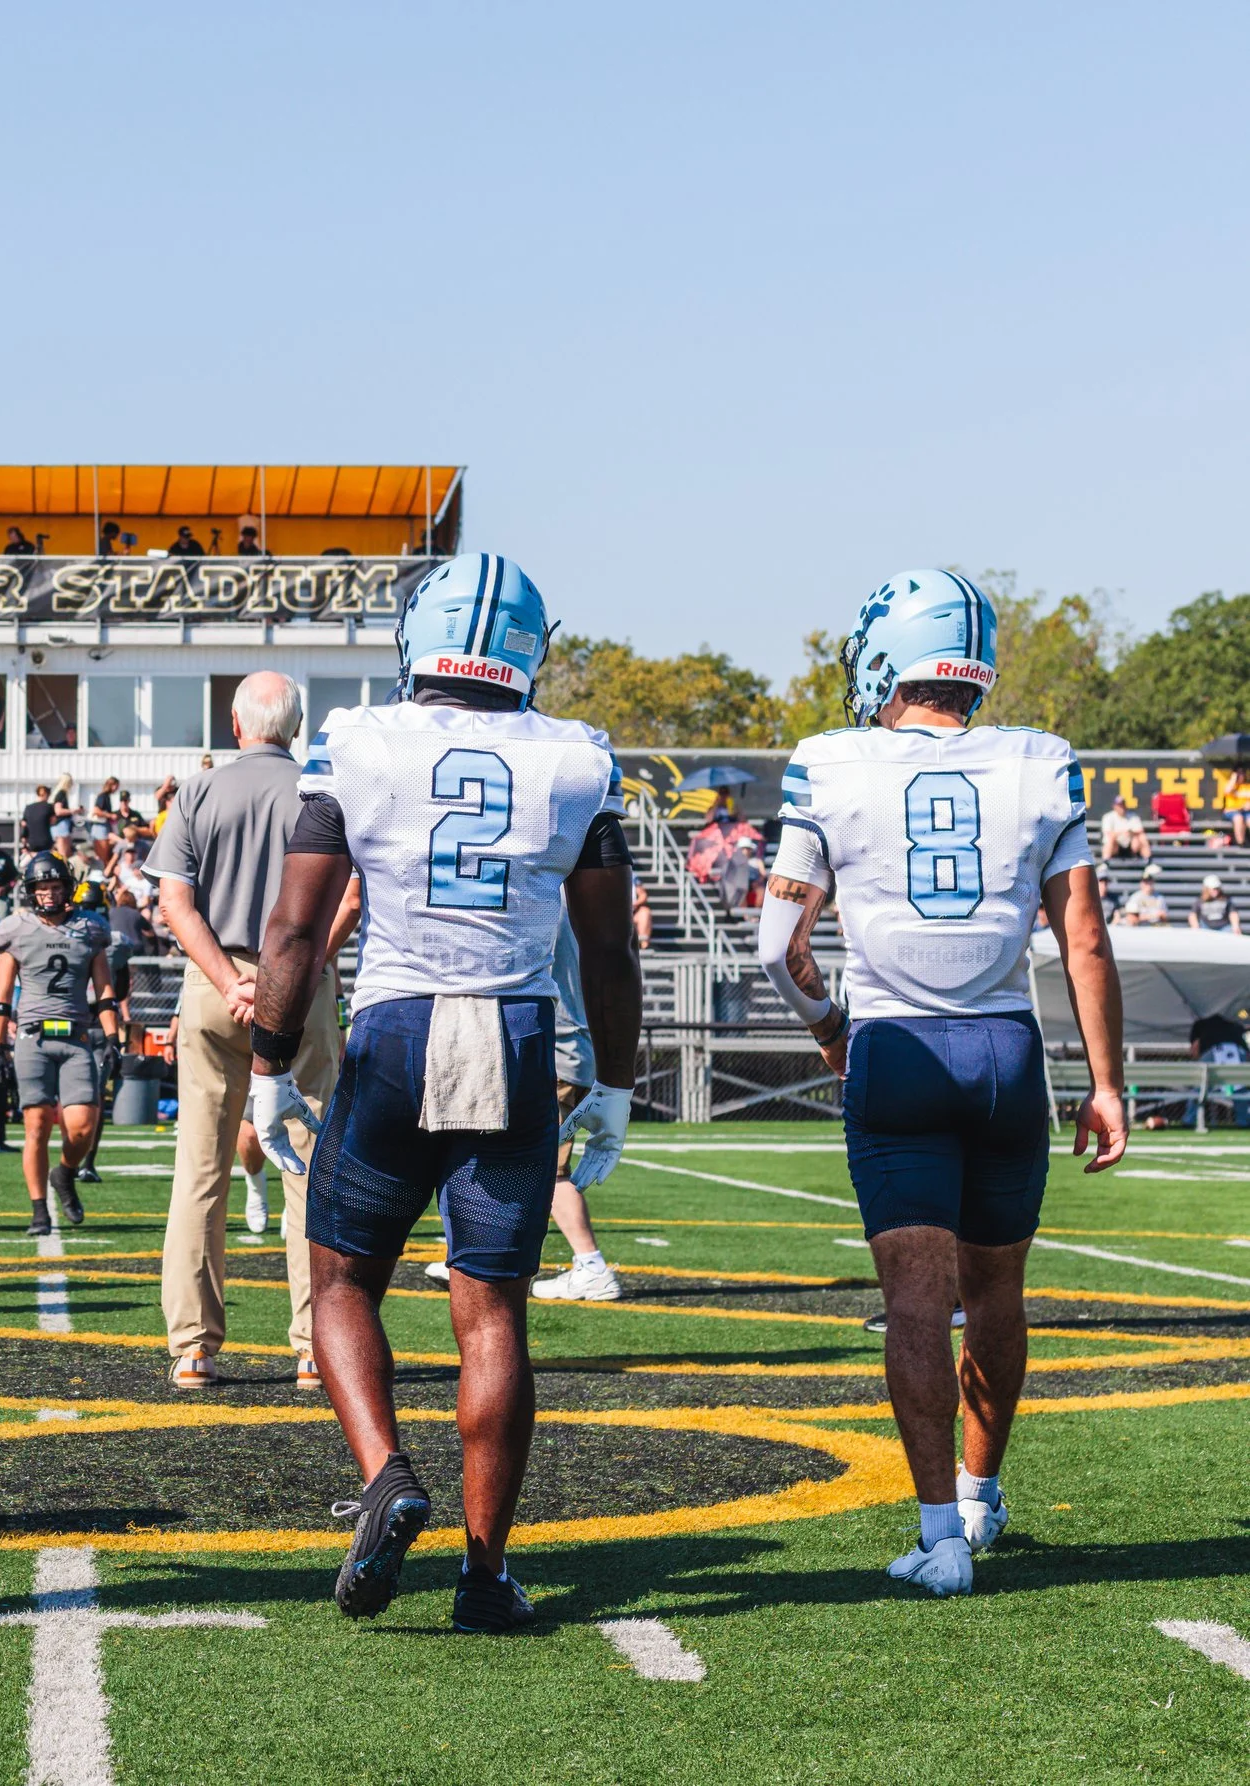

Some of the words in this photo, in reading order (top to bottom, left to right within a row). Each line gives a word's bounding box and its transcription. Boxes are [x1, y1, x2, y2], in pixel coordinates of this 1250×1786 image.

[51, 564, 398, 613] STADIUM
[437, 658, 513, 684] Riddell
[936, 662, 993, 685] Riddell
[426, 748, 514, 910] 2
[905, 772, 984, 920] 8
[46, 954, 69, 994] 2
